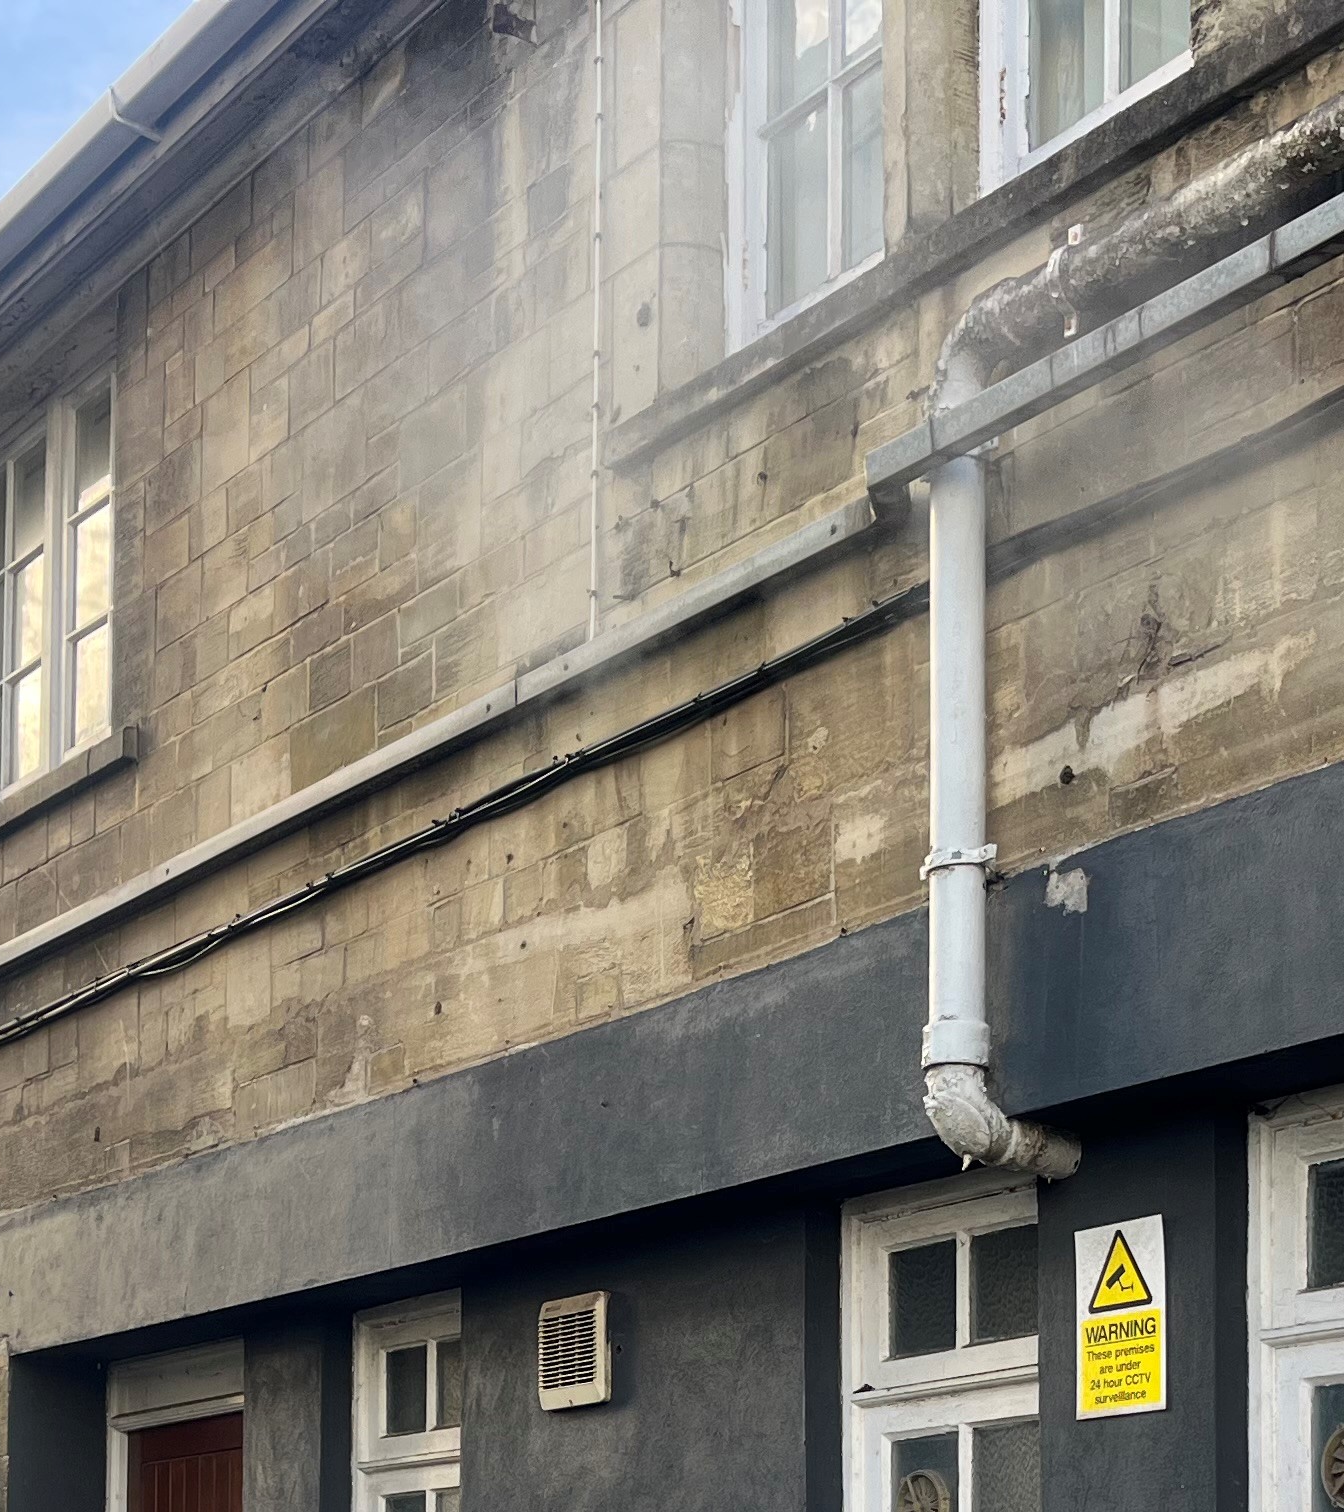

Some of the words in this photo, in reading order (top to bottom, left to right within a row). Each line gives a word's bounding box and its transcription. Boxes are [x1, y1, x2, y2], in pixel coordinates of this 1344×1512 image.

[1085, 1317, 1156, 1344] WARNING
[1087, 1350, 1112, 1362] These
[1115, 1344, 1155, 1360] premises
[1099, 1365, 1114, 1374] are
[1116, 1360, 1141, 1372] under
[1090, 1379, 1101, 1391] 24
[1103, 1378, 1123, 1389] hour
[1125, 1372, 1152, 1386] CCTV
[1095, 1390, 1147, 1404] surveillance
